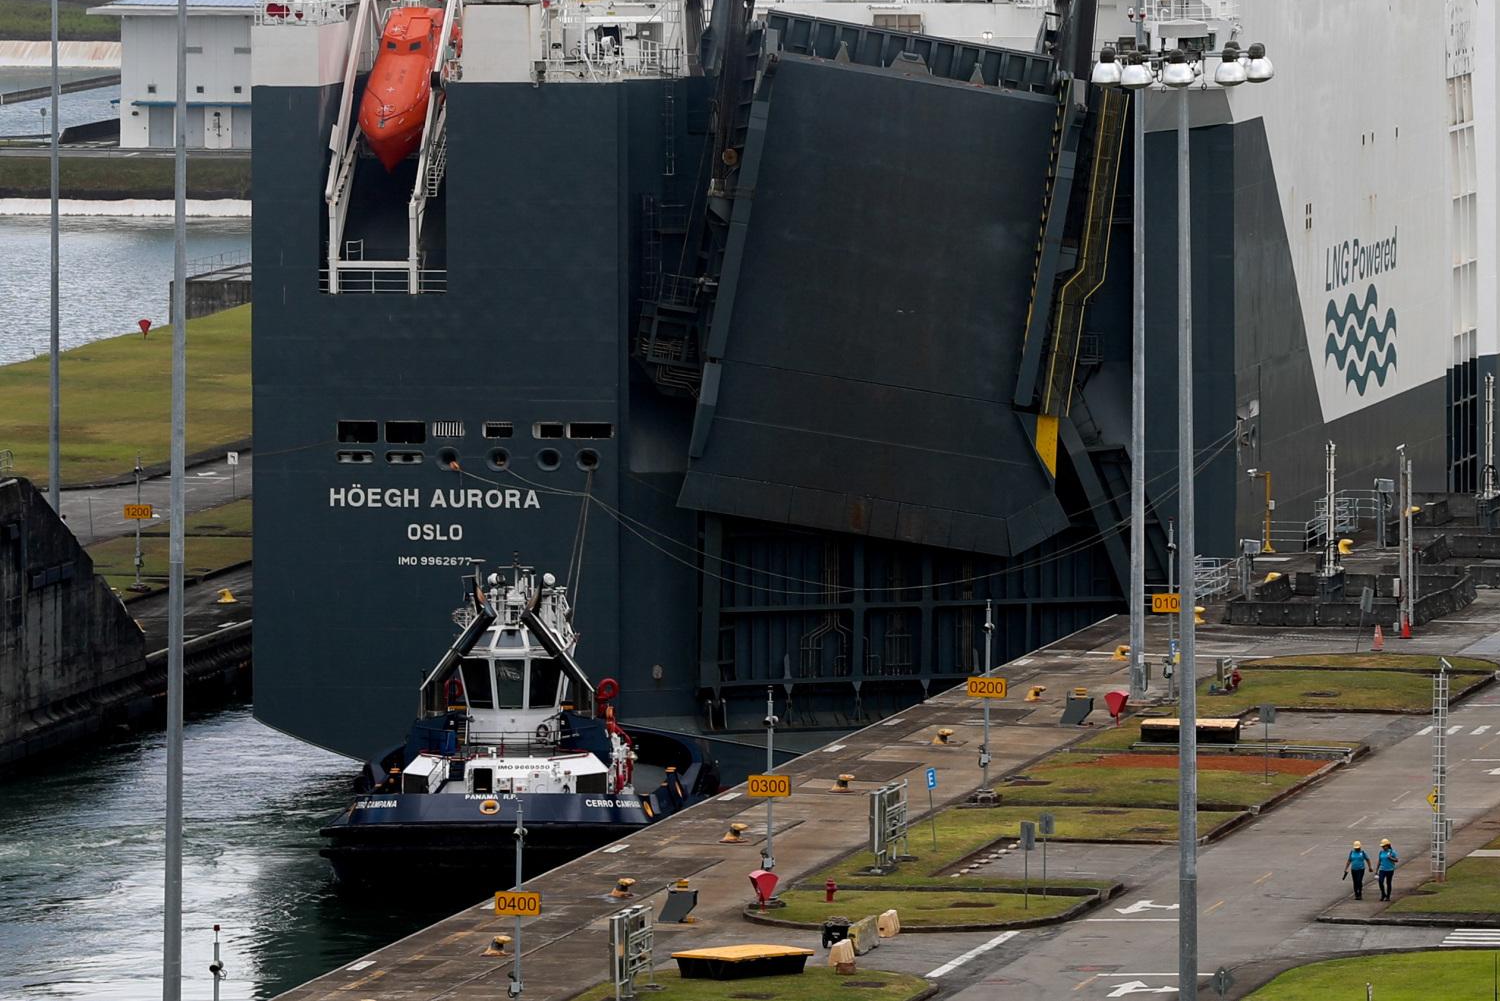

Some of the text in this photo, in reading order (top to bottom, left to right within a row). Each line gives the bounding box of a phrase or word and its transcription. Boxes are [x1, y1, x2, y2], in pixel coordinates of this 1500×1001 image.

[1325, 225, 1398, 292] LNG Powered
[329, 484, 541, 509] HÖEGH AURORA
[126, 508, 149, 517] 1200
[407, 523, 463, 541] OSLO
[398, 556, 472, 566] IMO 9962677
[1154, 597, 1180, 609] 010
[969, 681, 1004, 695] 0200
[751, 779, 787, 793] 0300
[927, 772, 935, 786] E
[366, 800, 398, 809] CAMPANA
[585, 799, 614, 808] CERRO
[497, 896, 537, 912] 0400
